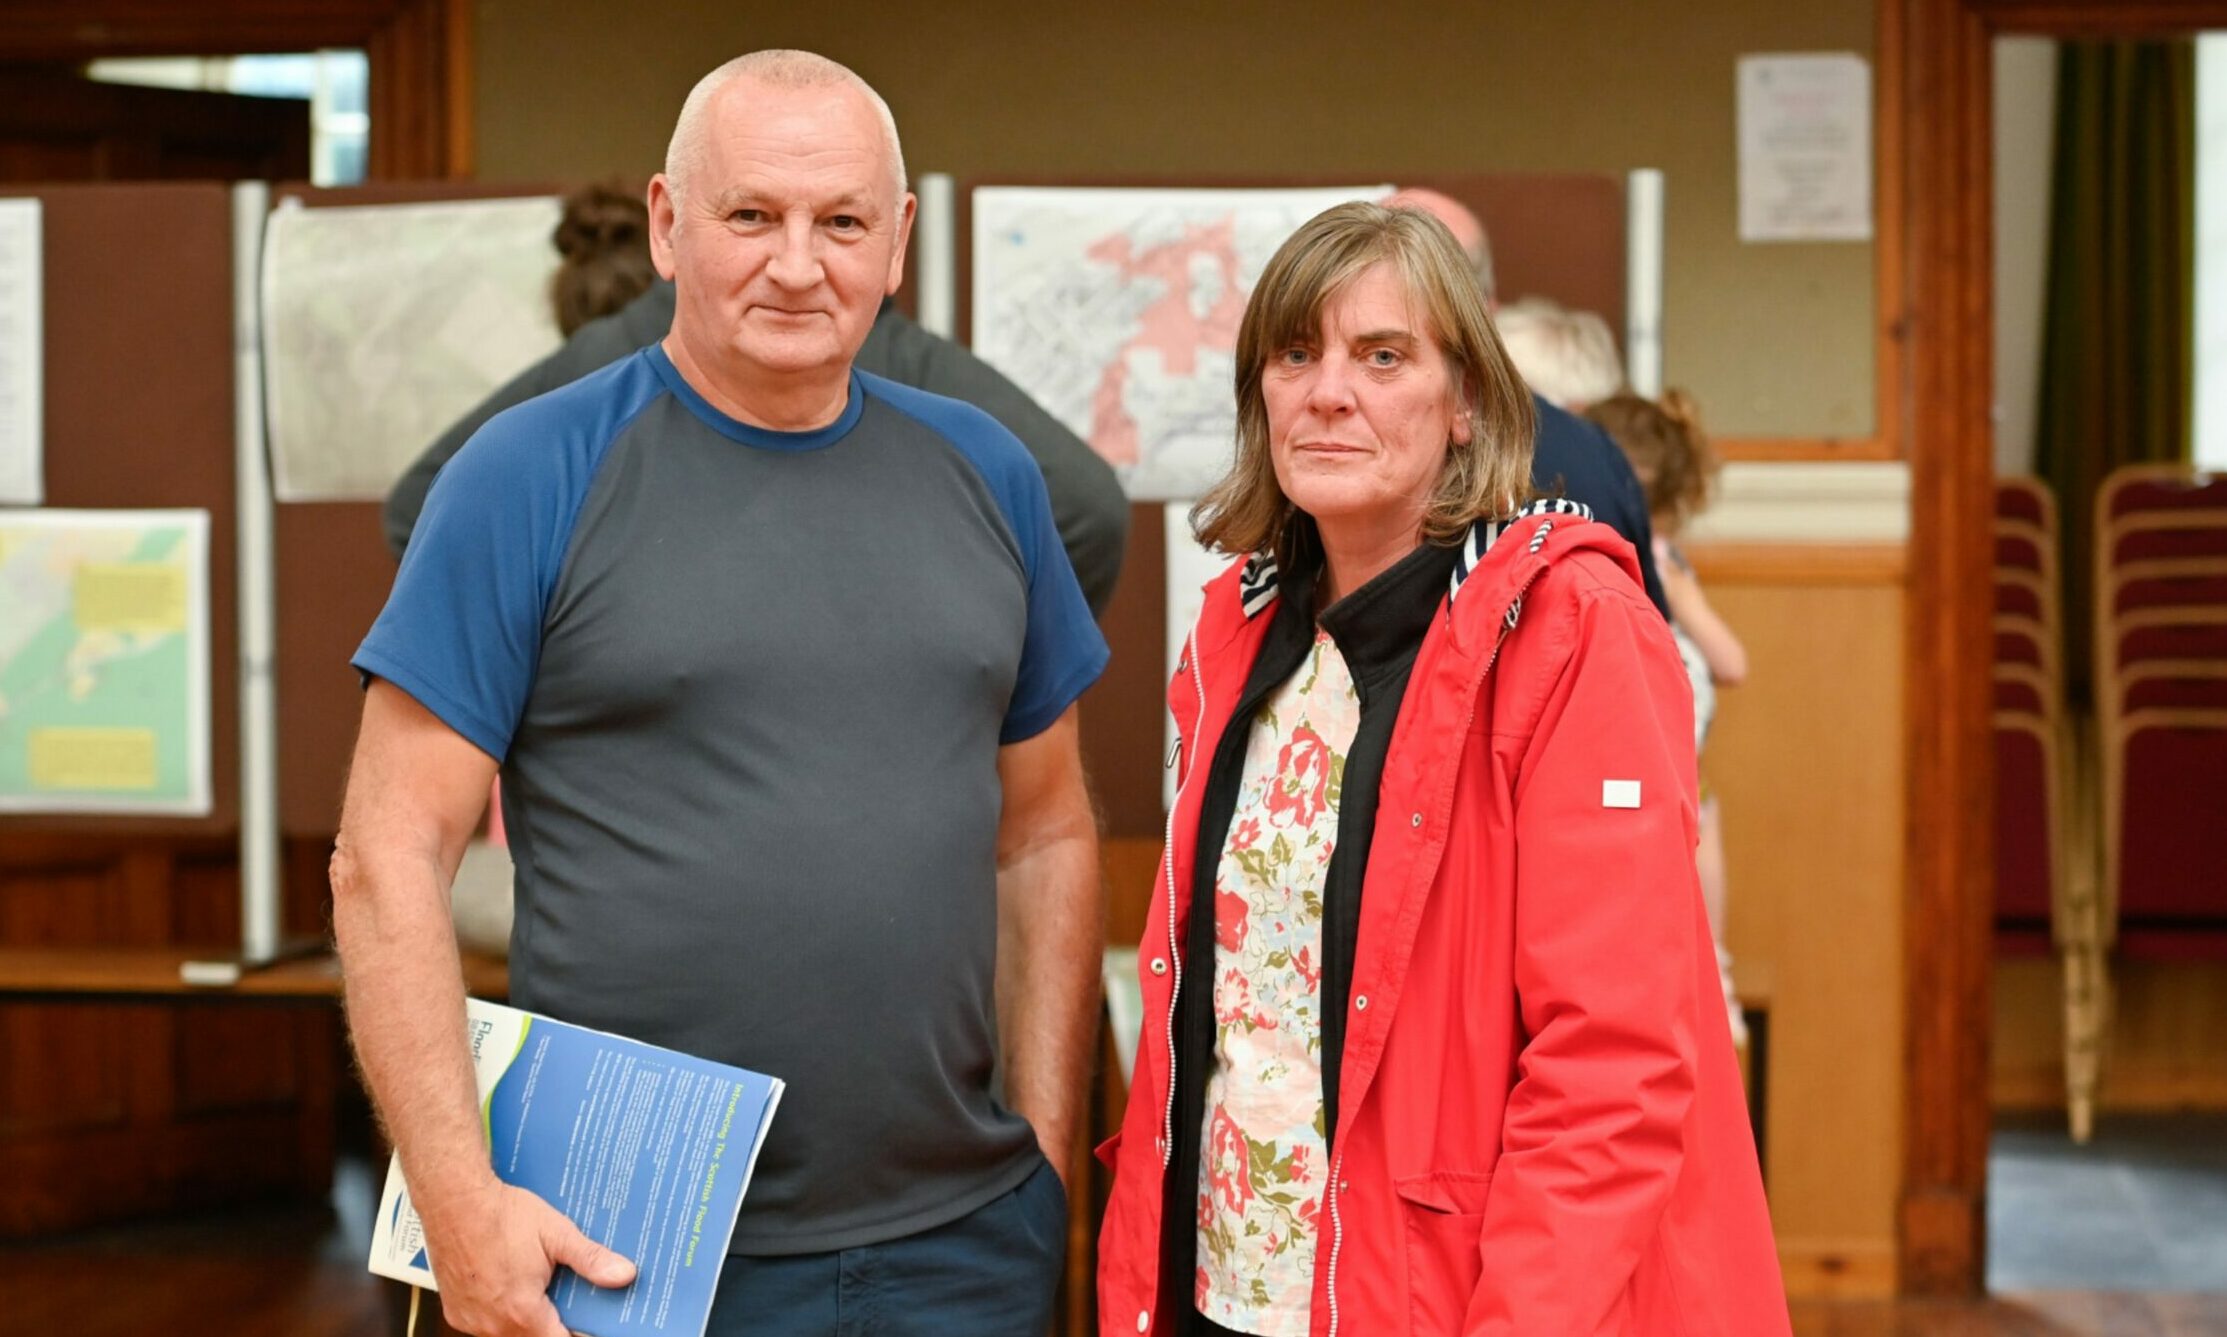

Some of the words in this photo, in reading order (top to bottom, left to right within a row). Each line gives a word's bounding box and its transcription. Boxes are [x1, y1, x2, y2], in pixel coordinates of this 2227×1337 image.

[717, 1083, 744, 1139] Introducing
[713, 1143, 726, 1160] The
[702, 1162, 720, 1202] Scottish
[693, 1205, 708, 1233] Flood
[685, 1235, 700, 1268] Forum
